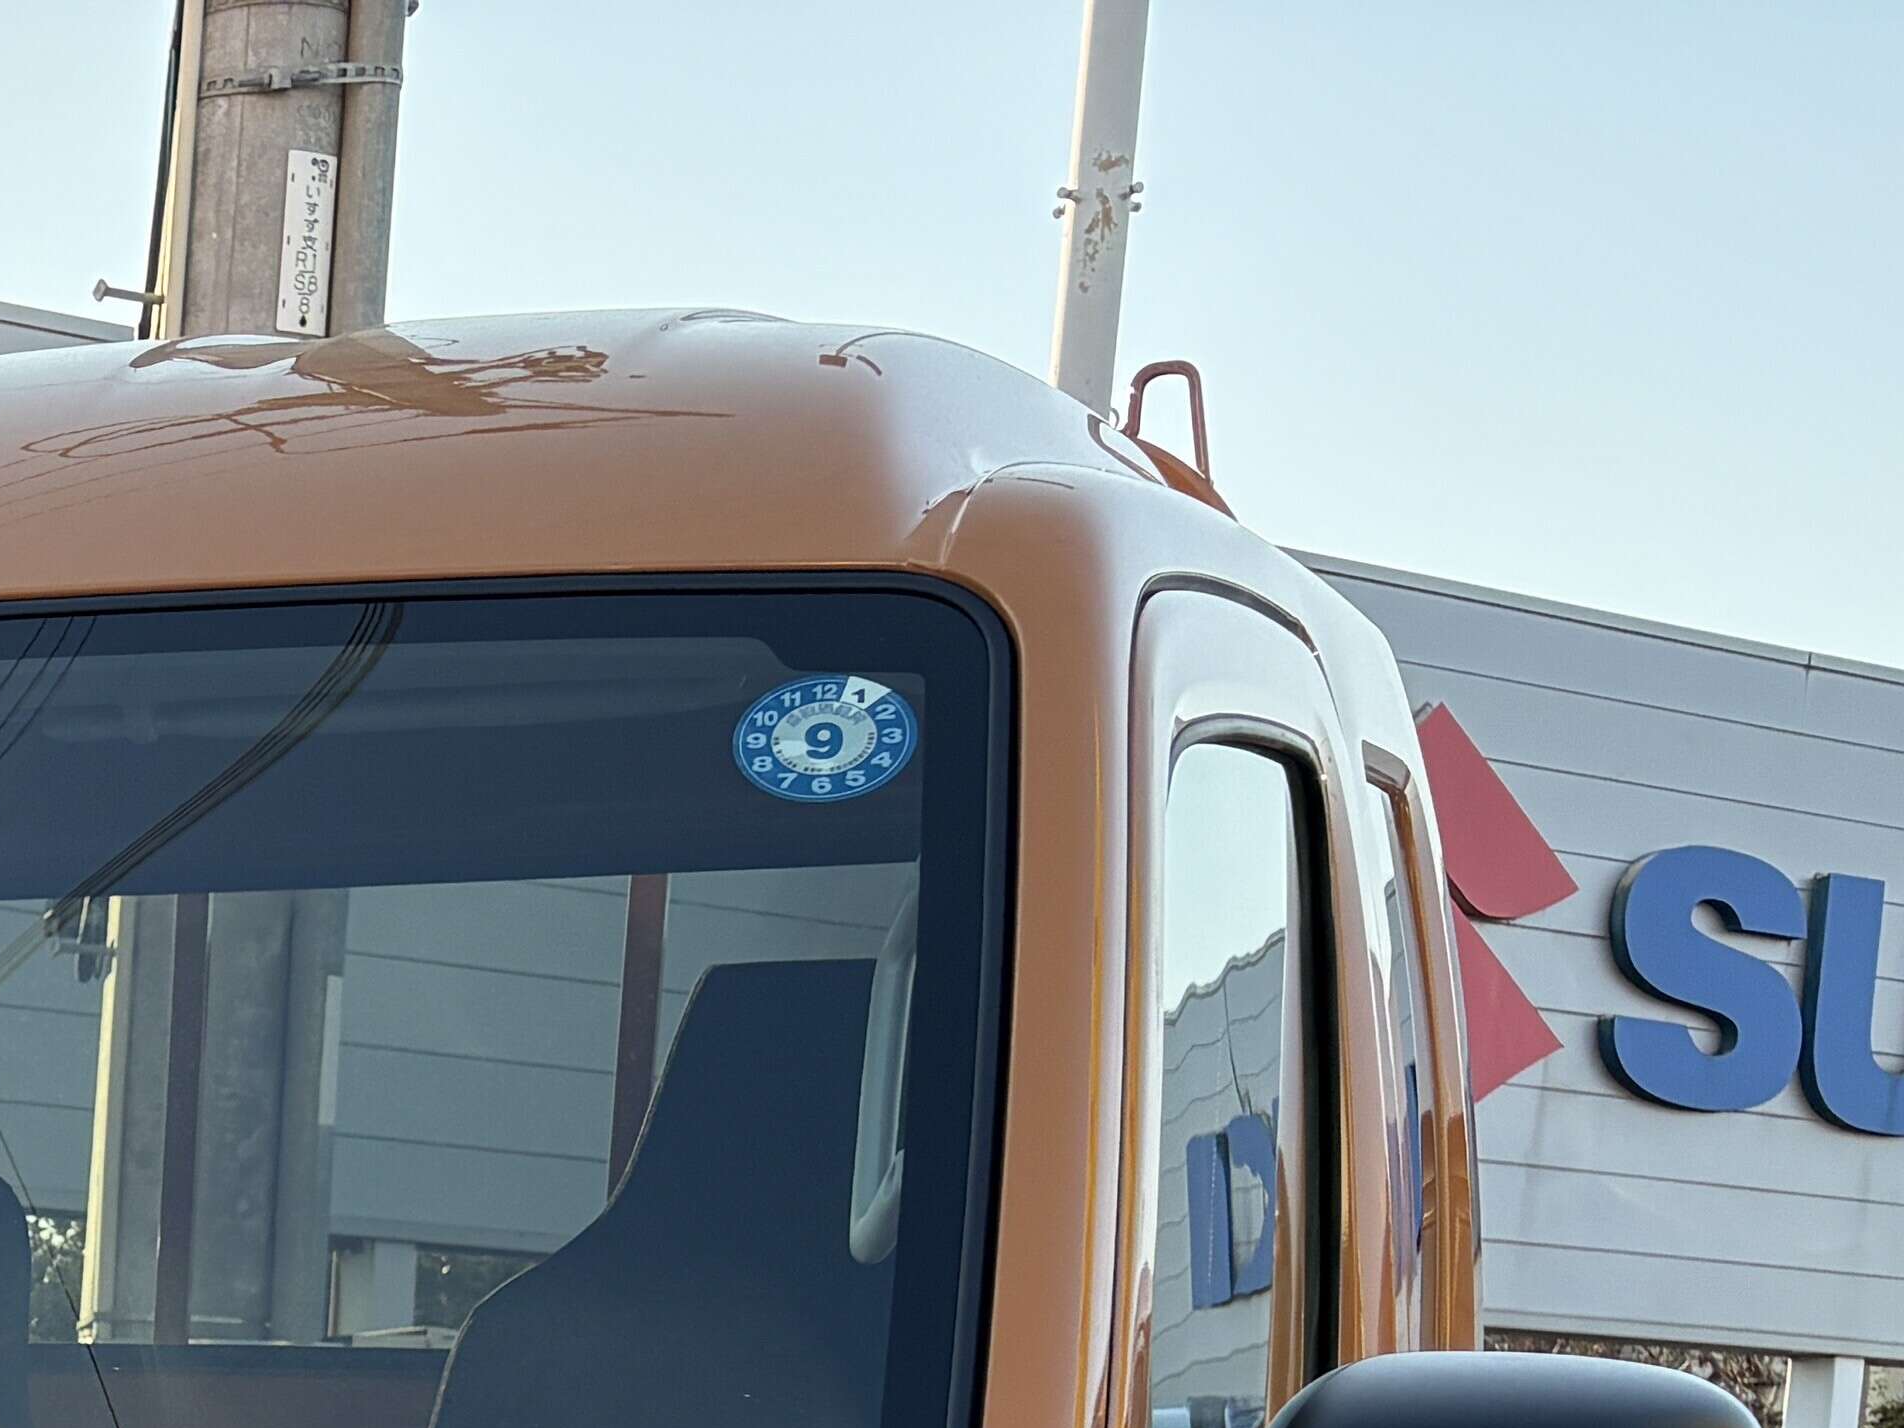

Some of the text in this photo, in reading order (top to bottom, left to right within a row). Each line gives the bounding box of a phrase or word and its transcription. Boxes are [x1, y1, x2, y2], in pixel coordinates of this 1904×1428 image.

[780, 691, 801, 707] 11
[812, 684, 837, 700] 12
[851, 688, 866, 703] 1
[753, 710, 778, 727] 10
[874, 704, 896, 720] 2
[746, 733, 767, 749] 9
[805, 722, 843, 760] 9
[881, 728, 903, 744] 3
[752, 756, 772, 772] 8
[871, 752, 892, 768] 4
[777, 773, 798, 788] 7
[811, 777, 832, 793] 6
[845, 770, 866, 786] 5
